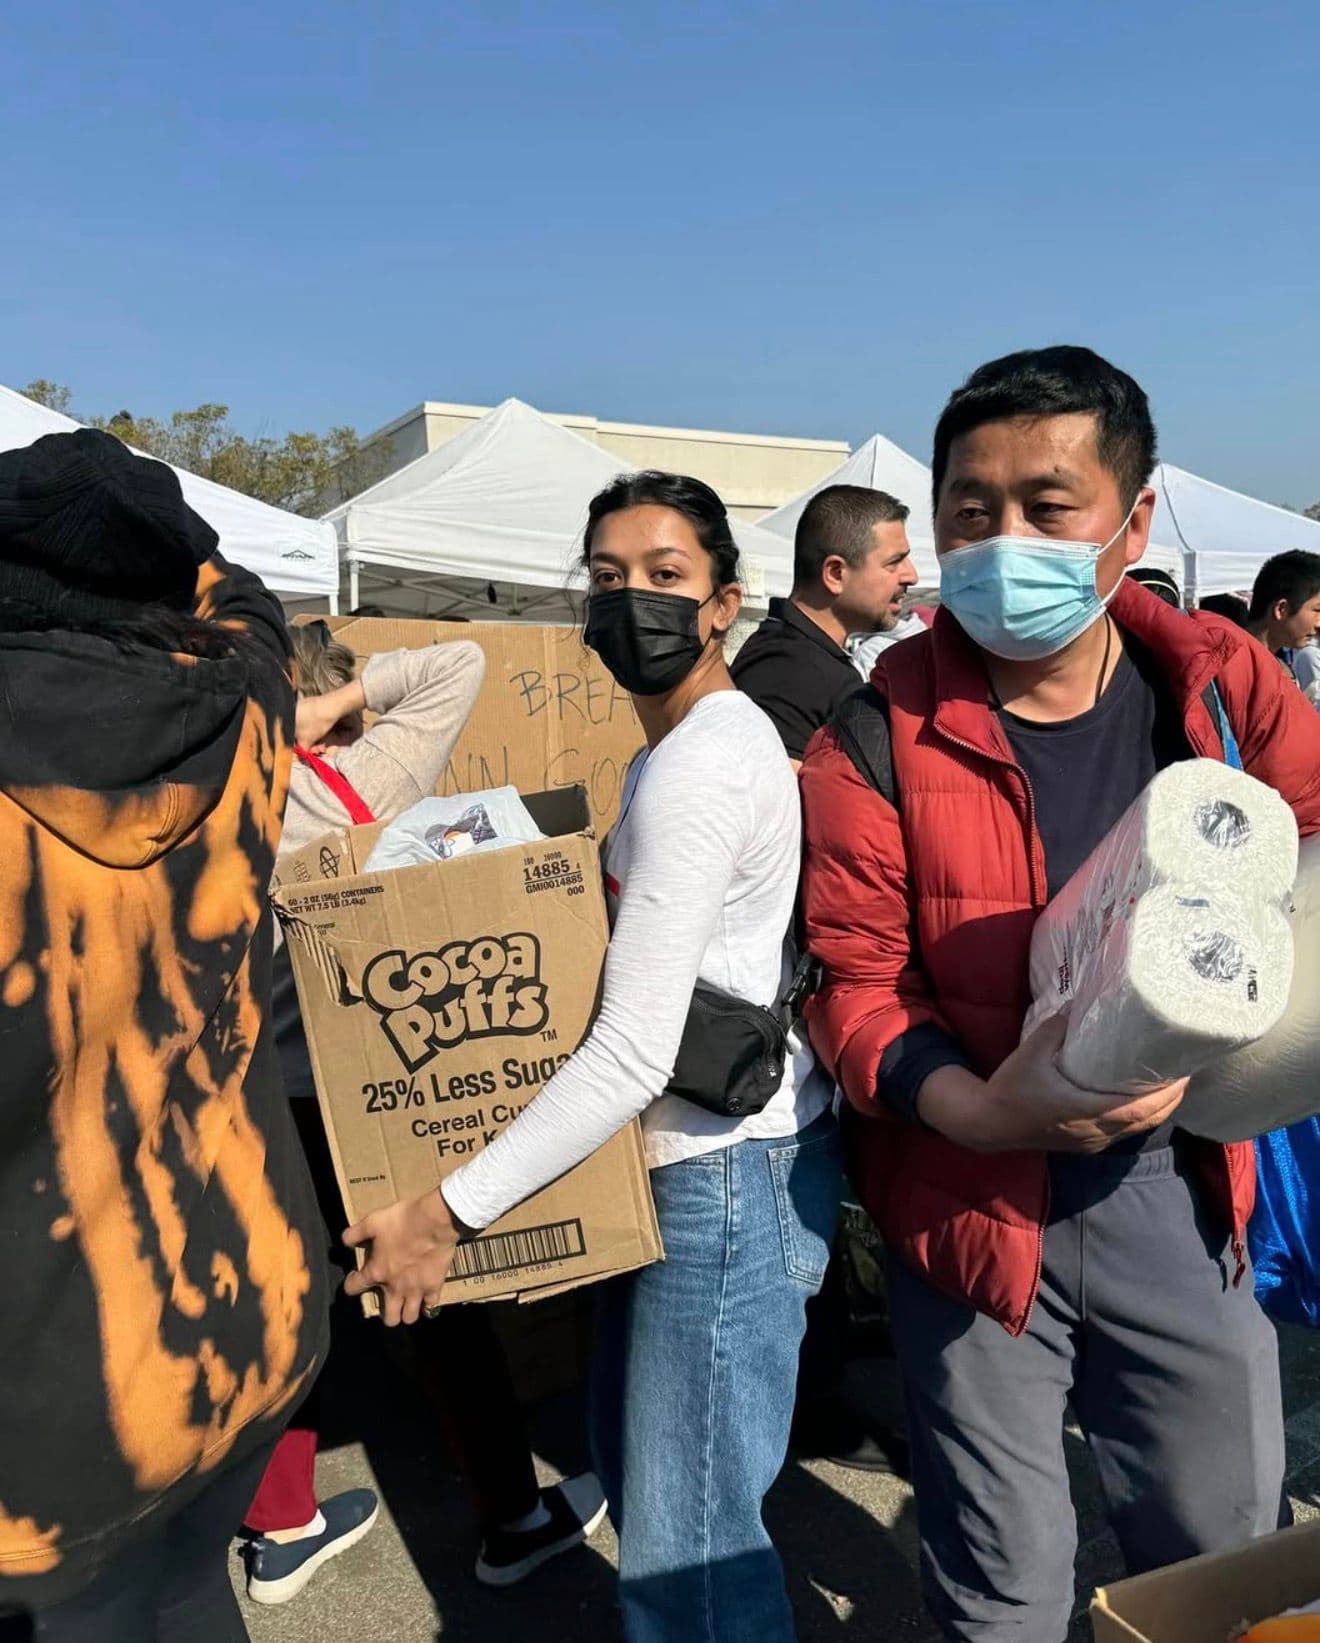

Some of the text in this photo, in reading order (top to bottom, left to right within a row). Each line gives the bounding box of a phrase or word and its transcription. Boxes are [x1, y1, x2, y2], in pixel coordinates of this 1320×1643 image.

[523, 859, 570, 881] 14885
[341, 885, 385, 899] CONTAINERS
[566, 885, 585, 896] 000
[362, 932, 541, 1012] Cocoa
[380, 974, 550, 1075] Puffs
[361, 1076, 425, 1114] 25%
[430, 1070, 497, 1104] Less
[411, 1104, 529, 1138] Cereal Cu
[437, 1137, 476, 1157] For
